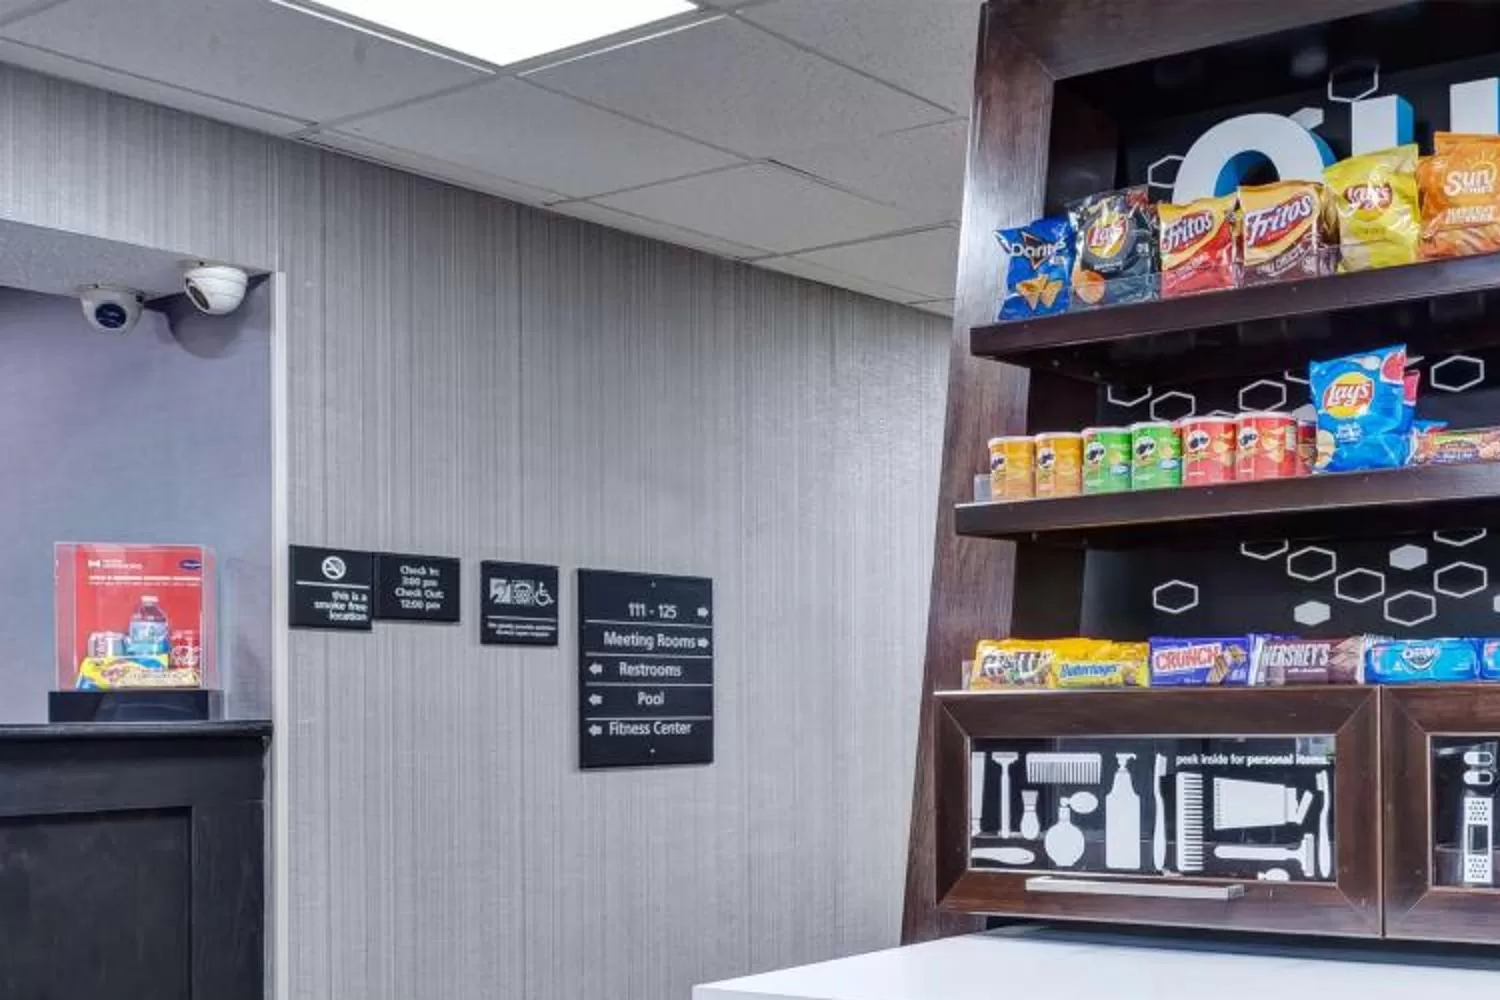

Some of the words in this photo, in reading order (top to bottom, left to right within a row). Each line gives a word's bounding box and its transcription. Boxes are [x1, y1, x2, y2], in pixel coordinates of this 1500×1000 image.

[1245, 194, 1312, 246] Fritos
[1161, 211, 1213, 251] Fritos
[332, 591, 350, 601] this
[352, 592, 360, 601] is
[395, 588, 421, 598] Check
[314, 601, 346, 611] smoke
[349, 601, 368, 612] free
[628, 602, 646, 617] 111
[658, 604, 677, 619] 125
[329, 610, 368, 621] location
[603, 631, 654, 649] Meeting
[657, 633, 696, 648] Rooms
[1155, 645, 1222, 671] CRUNCH
[619, 662, 682, 677] Restrooms
[637, 692, 665, 705] Pool
[609, 722, 650, 736] Fitness
[653, 722, 692, 735] Center
[1176, 754, 1199, 767] peek
[1201, 753, 1228, 765] inside
[1230, 753, 1245, 765] for
[1247, 753, 1294, 767] personal
